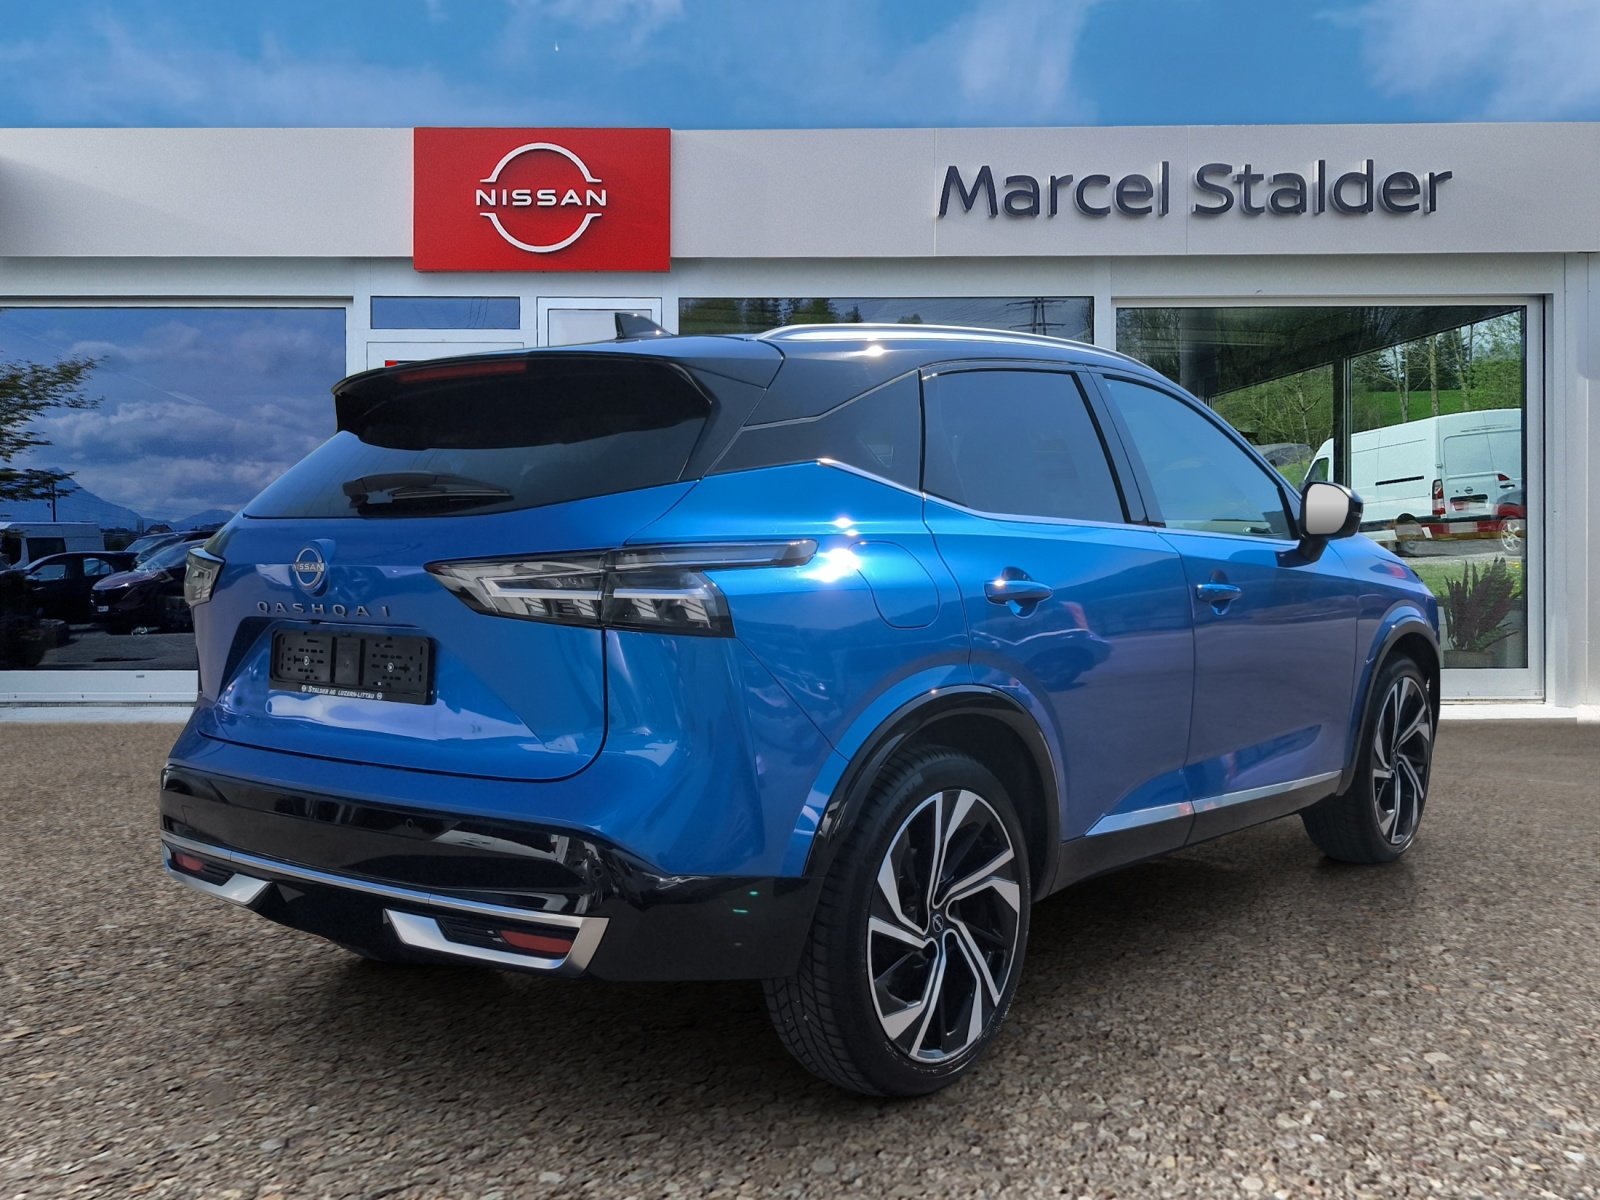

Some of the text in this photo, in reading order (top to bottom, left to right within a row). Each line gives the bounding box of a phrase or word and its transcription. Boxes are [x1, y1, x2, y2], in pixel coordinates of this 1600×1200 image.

[937, 158, 1453, 218] Marcel Stalder
[475, 189, 607, 206] NISSAN
[256, 601, 390, 617] QASHQAI
[308, 685, 329, 695] STALDER
